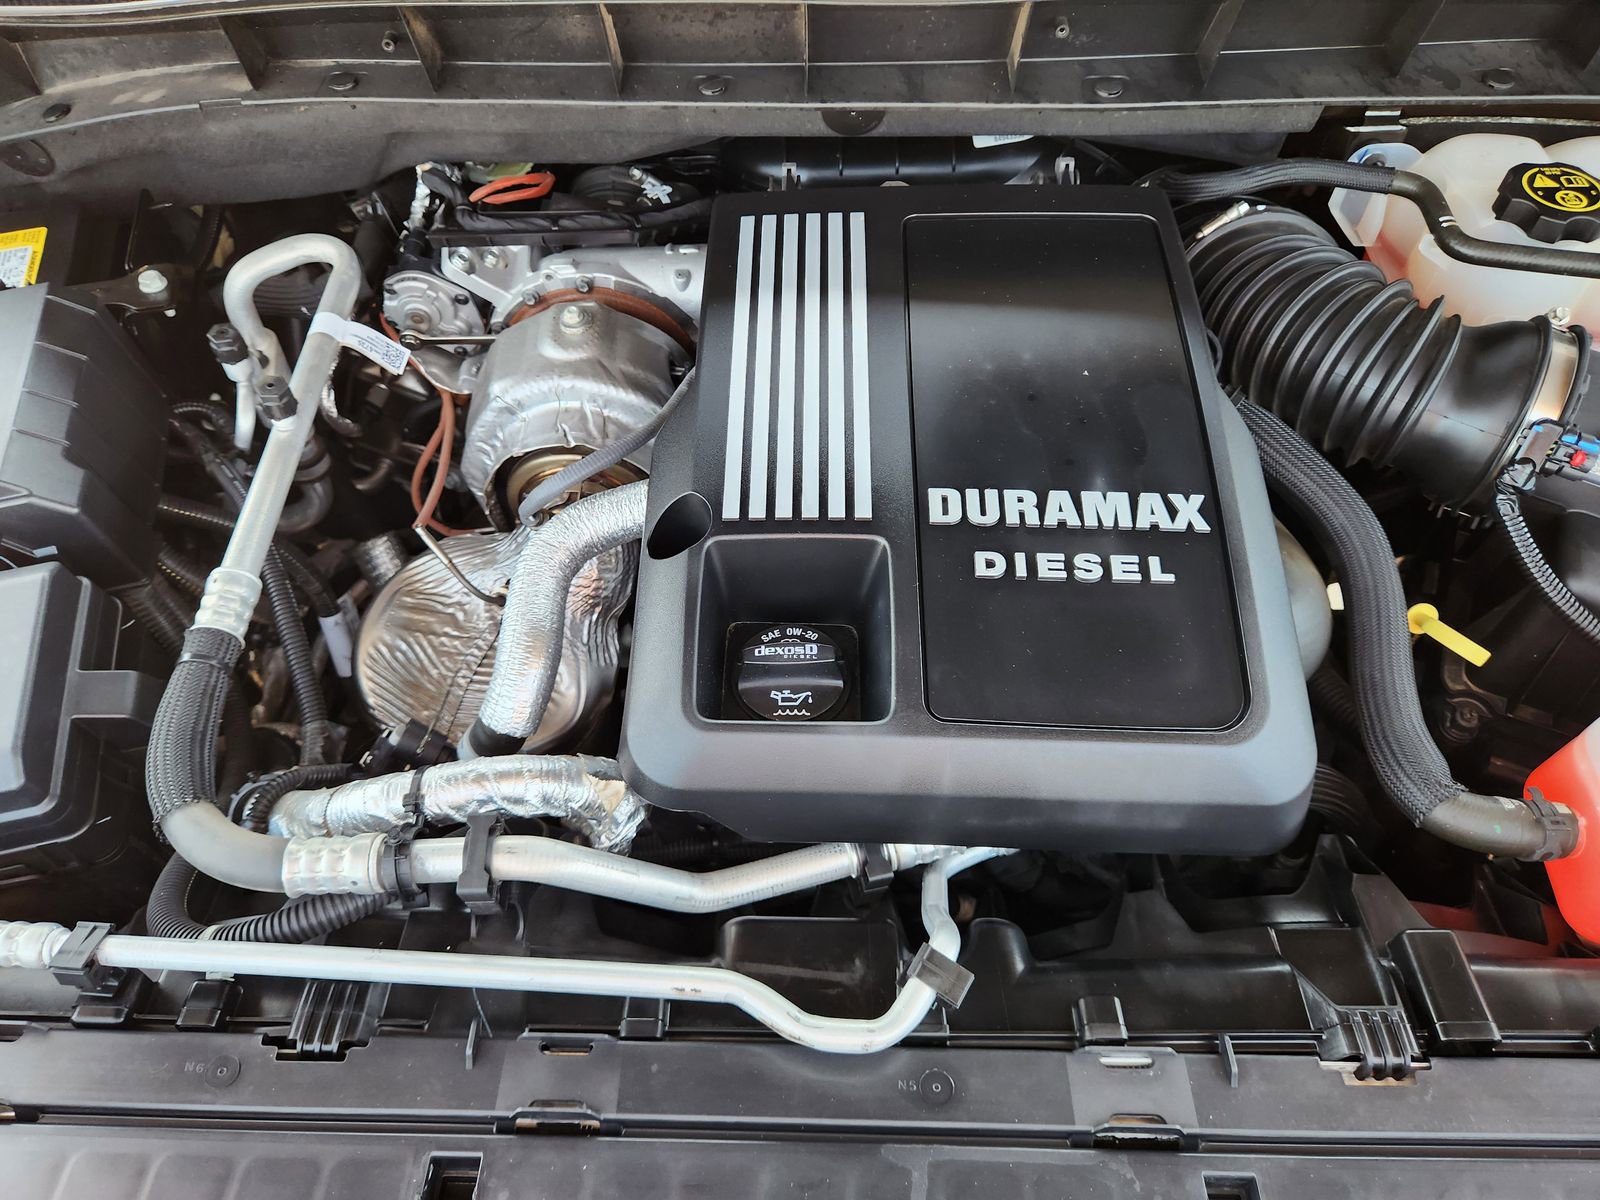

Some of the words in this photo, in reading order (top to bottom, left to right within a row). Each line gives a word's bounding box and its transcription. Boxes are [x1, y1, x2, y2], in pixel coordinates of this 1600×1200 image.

[927, 487, 1211, 533] DURAMAX
[974, 551, 1176, 585] DIESEL
[761, 629, 782, 642] SAE
[786, 627, 818, 641] 0W-20
